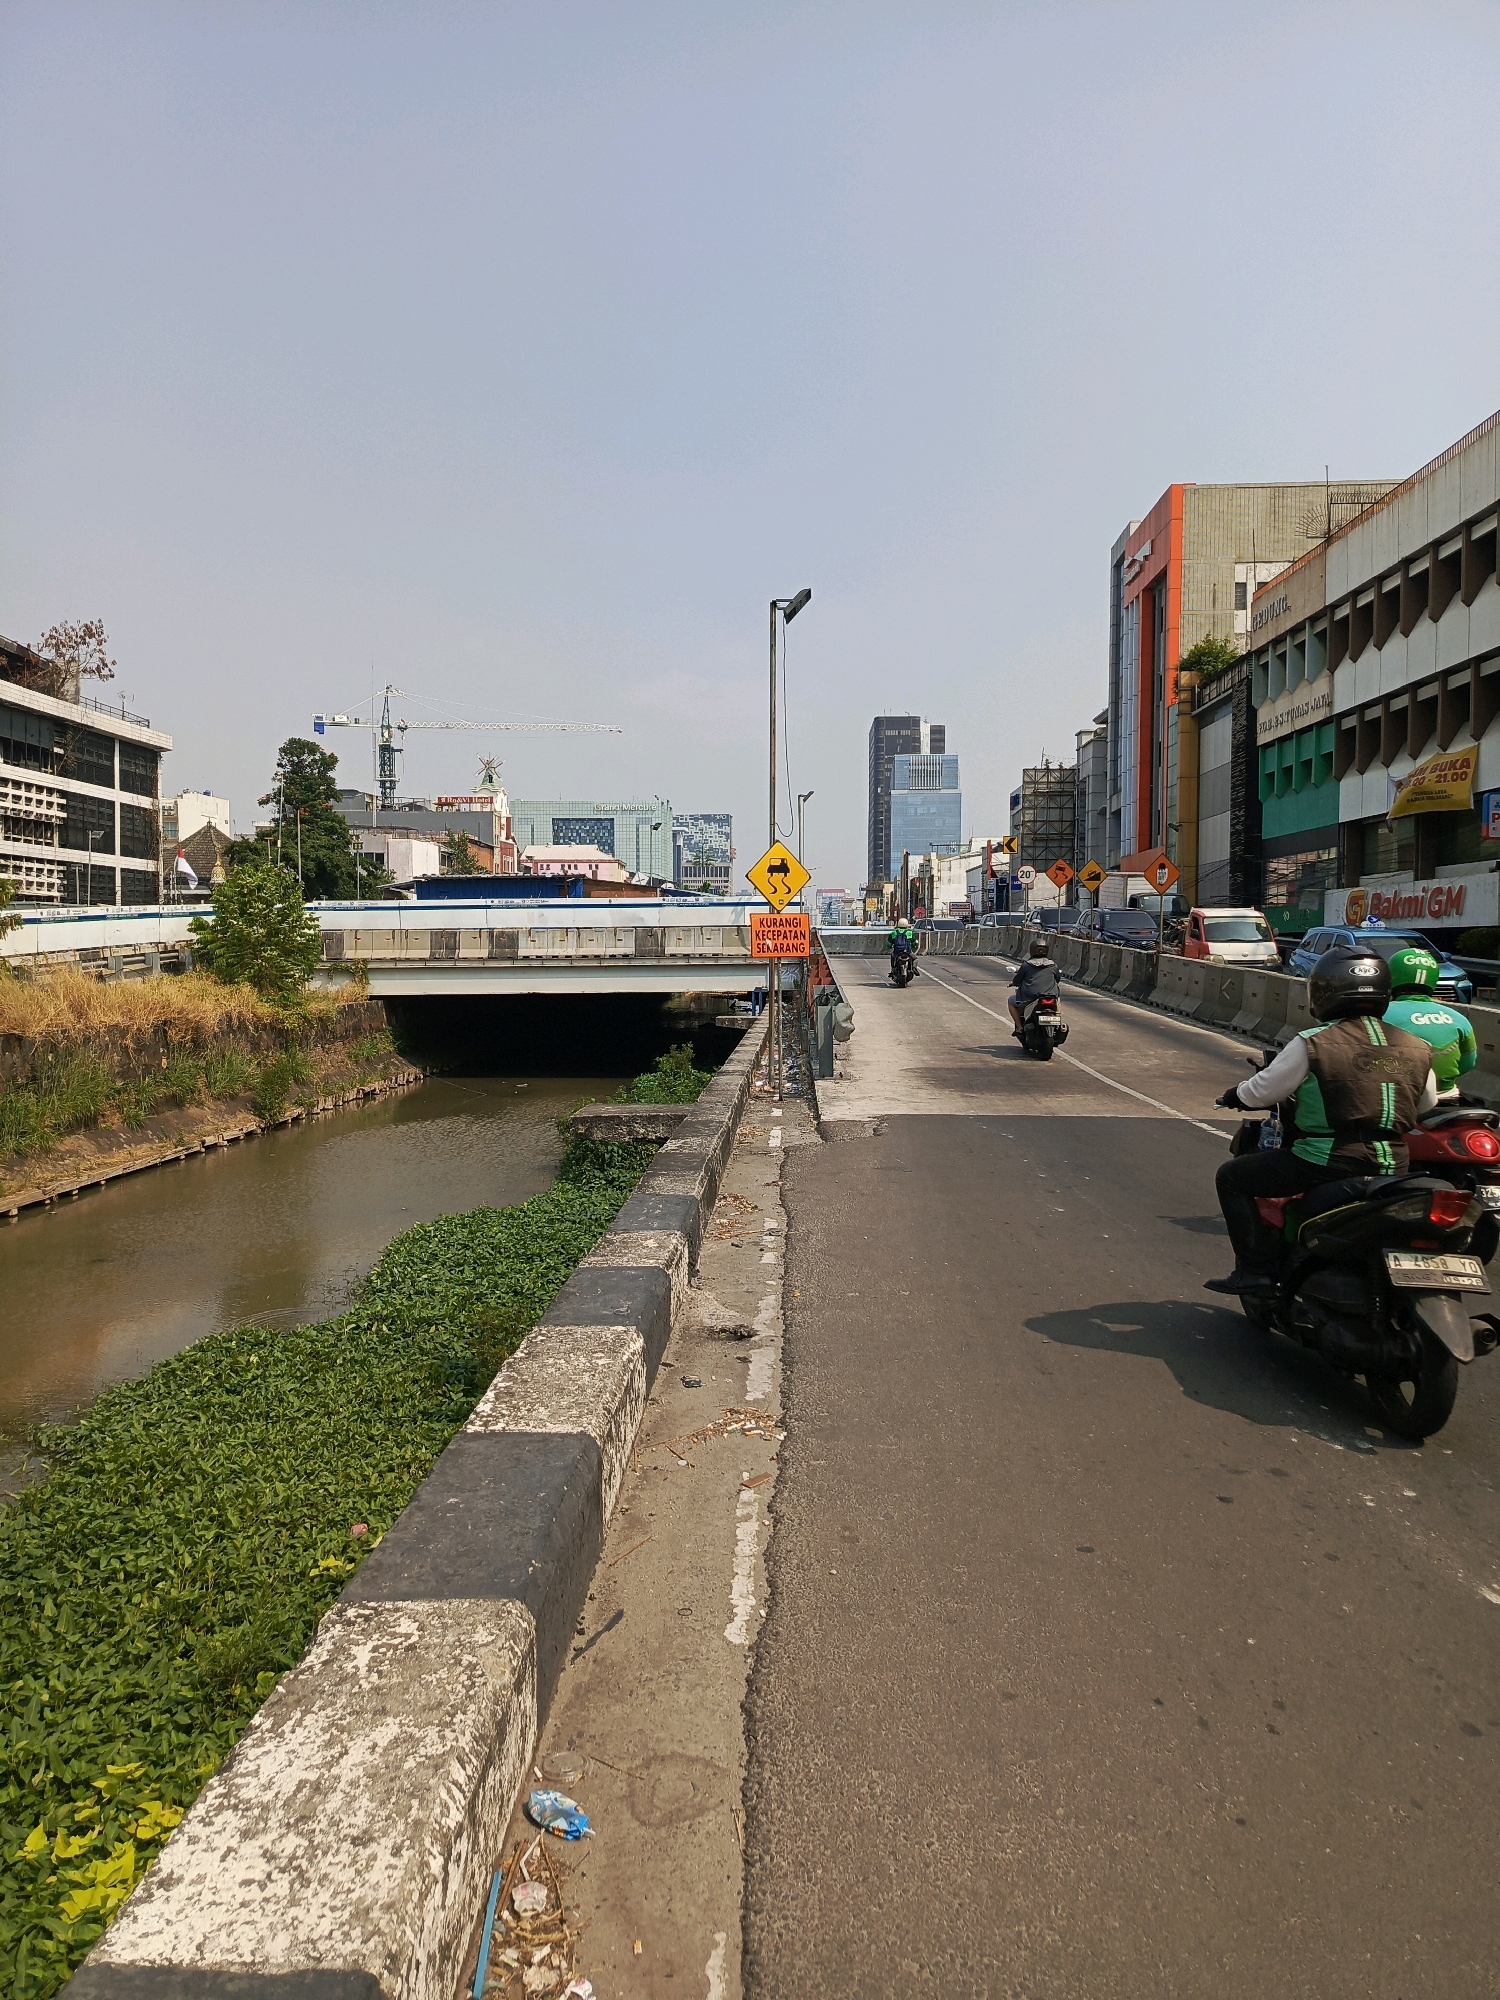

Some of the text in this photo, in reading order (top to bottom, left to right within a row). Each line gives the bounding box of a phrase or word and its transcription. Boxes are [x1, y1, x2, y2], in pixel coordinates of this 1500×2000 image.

[1252, 594, 1288, 632] GEDUNG
[1429, 757, 1471, 774] BUKA
[1435, 770, 1468, 784] 21.00
[594, 803, 657, 812] Grand Mercure
[1019, 870, 1031, 879] 20
[1369, 886, 1427, 920] Bakmi
[1427, 884, 1466, 919] GM
[759, 917, 802, 929] KURANGI
[755, 930, 806, 941] KECEPATAN
[1403, 955, 1437, 970] Grab
[1410, 1010, 1454, 1025] Grab
[1352, 1050, 1415, 1076] Grab
[1393, 1254, 1402, 1268] A
